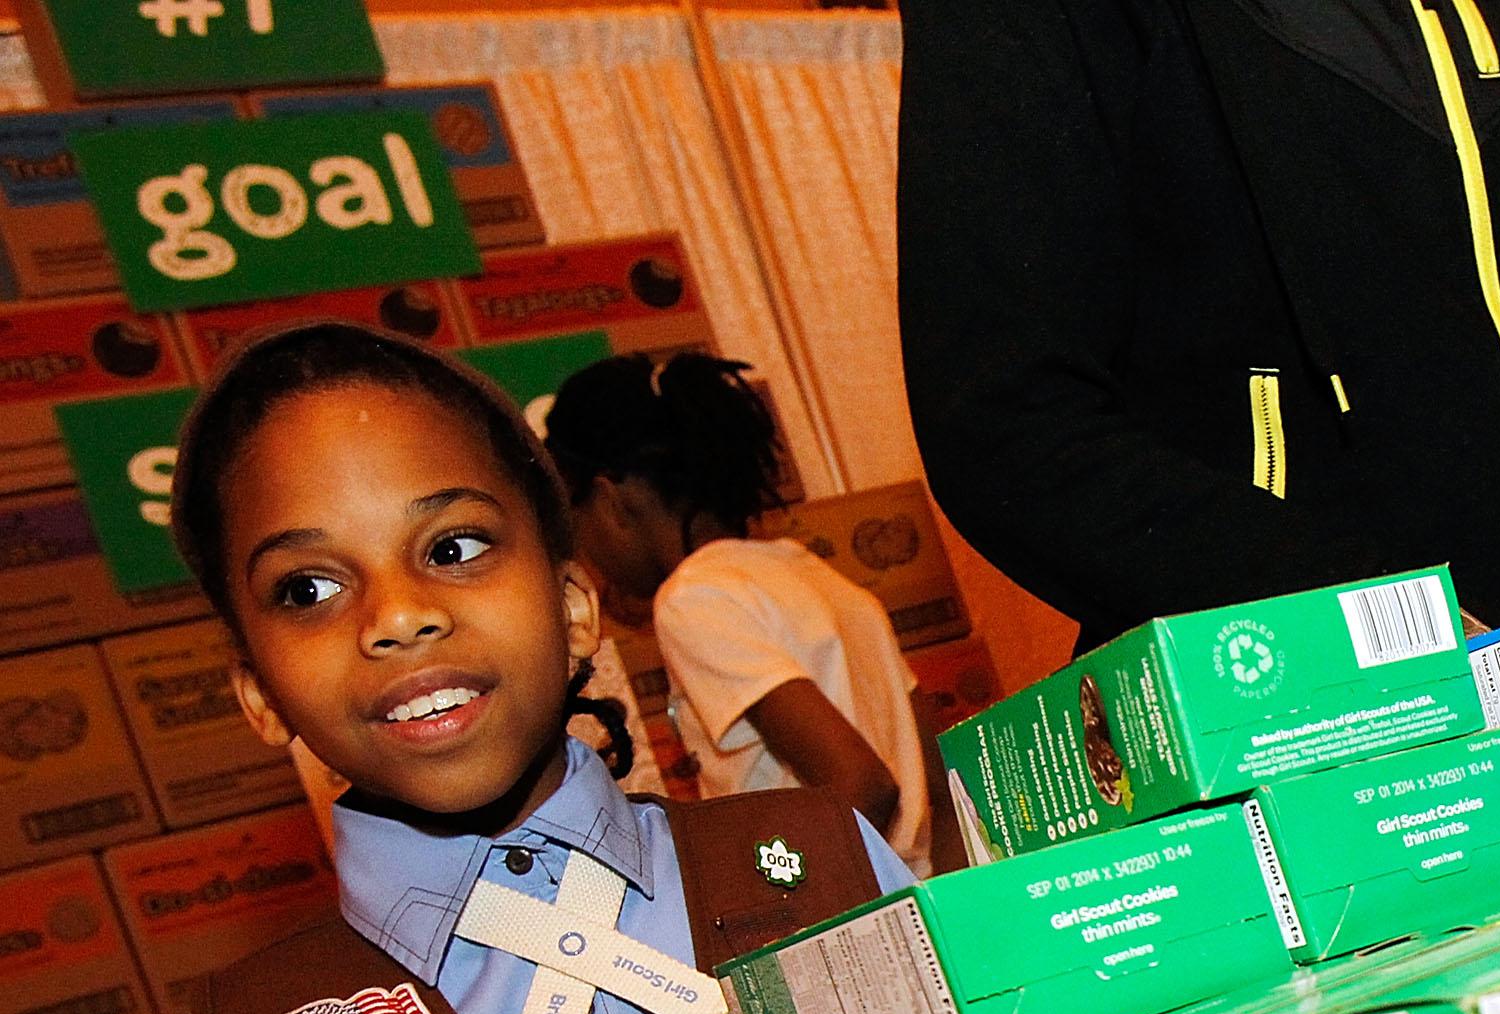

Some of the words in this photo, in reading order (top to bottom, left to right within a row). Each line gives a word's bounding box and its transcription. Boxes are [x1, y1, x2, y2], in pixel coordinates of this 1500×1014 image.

[136, 132, 434, 281] goal
[1217, 618, 1275, 641] RECYCLED
[1479, 653, 1493, 675] Total
[1487, 678, 1497, 692] Fat
[972, 724, 1002, 799] PROGRAM
[1353, 787, 1376, 804] SEP
[1377, 784, 1391, 798] 01
[1391, 778, 1416, 795] 2014
[1425, 765, 1467, 789] 3422931
[1375, 816, 1402, 835] Girl
[1398, 806, 1438, 829] Scout
[1435, 794, 1484, 819] Cookies
[1401, 828, 1430, 848] thin
[766, 853, 795, 869] 100
[1024, 878, 1055, 900] SEP
[1053, 874, 1072, 892] 01
[1070, 866, 1101, 887] 2014
[1111, 849, 1162, 879] 3422931
[1249, 805, 1281, 886] Nutrition
[1279, 893, 1300, 943] Facts
[1420, 855, 1443, 870] open
[1440, 848, 1464, 863] here
[1048, 908, 1081, 931] Girl
[1076, 895, 1124, 923] Scout
[1120, 881, 1179, 911] Cookies
[1080, 920, 1114, 944] thin
[1102, 949, 1132, 968] open
[1128, 941, 1155, 959] here
[611, 955, 665, 993] Scout
[665, 971, 699, 1005] Girl
